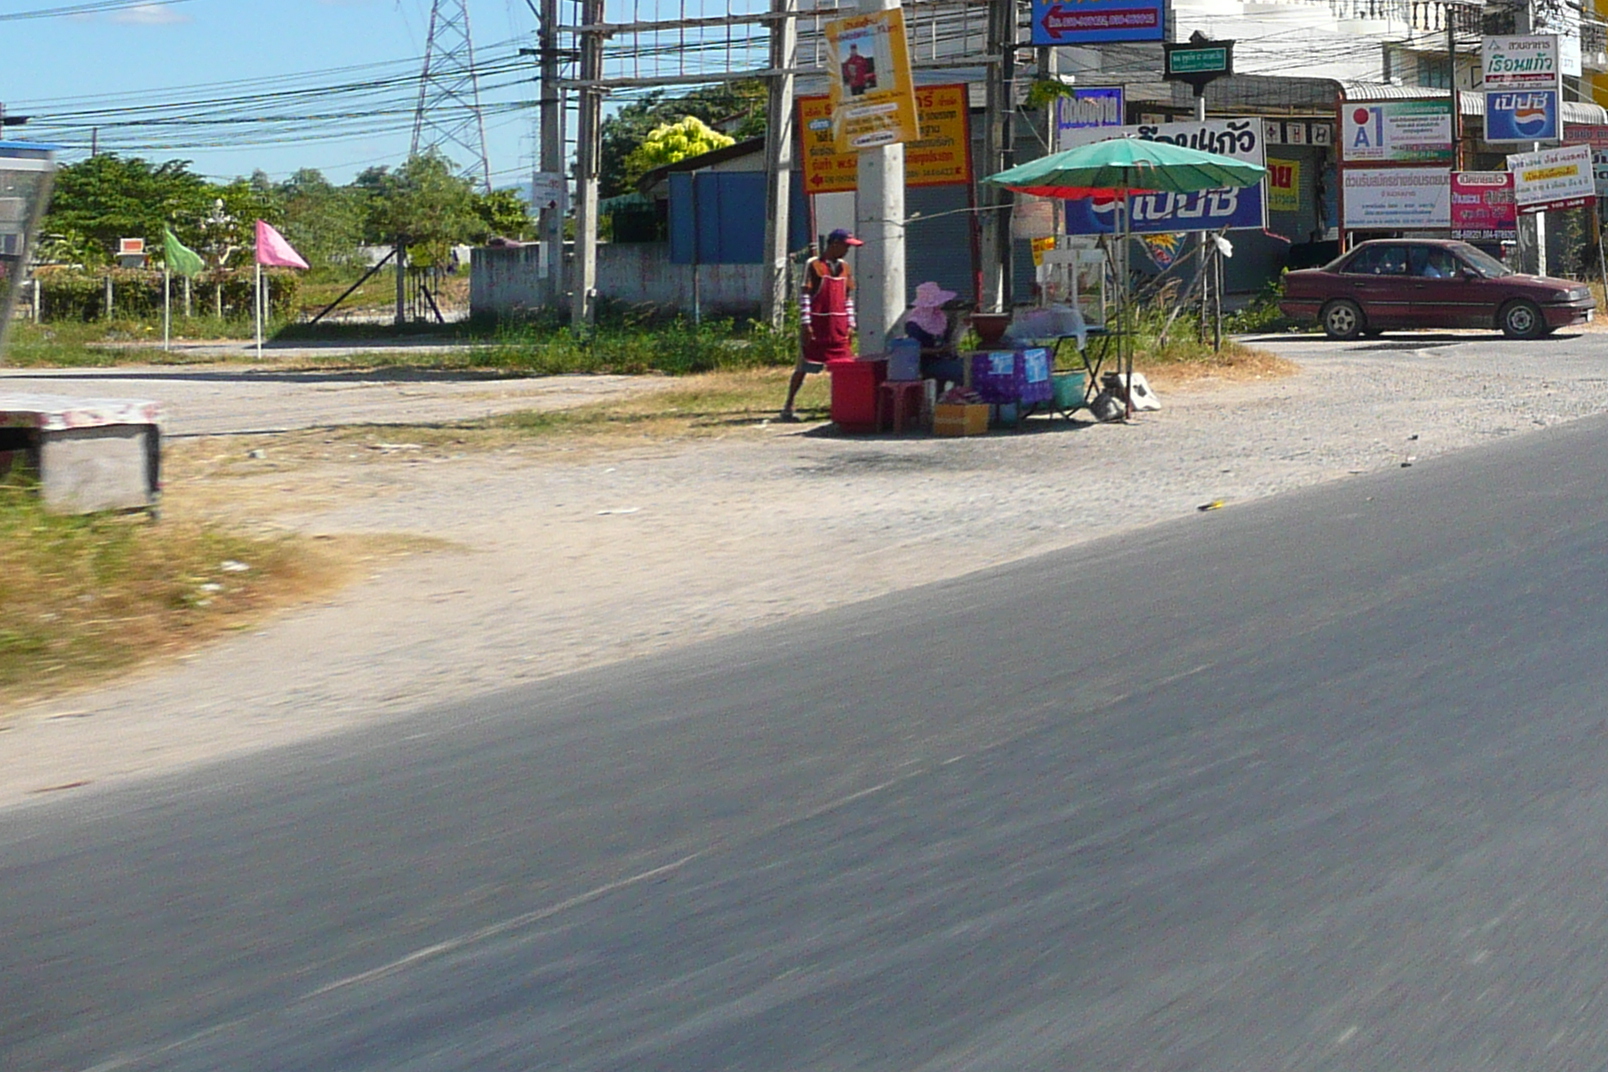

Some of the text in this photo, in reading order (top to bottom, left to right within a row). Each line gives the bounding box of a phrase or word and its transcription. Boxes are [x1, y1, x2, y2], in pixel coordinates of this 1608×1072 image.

[1508, 40, 1551, 51] สวนอาหาร
[1487, 52, 1553, 73] เรือนแก้ว
